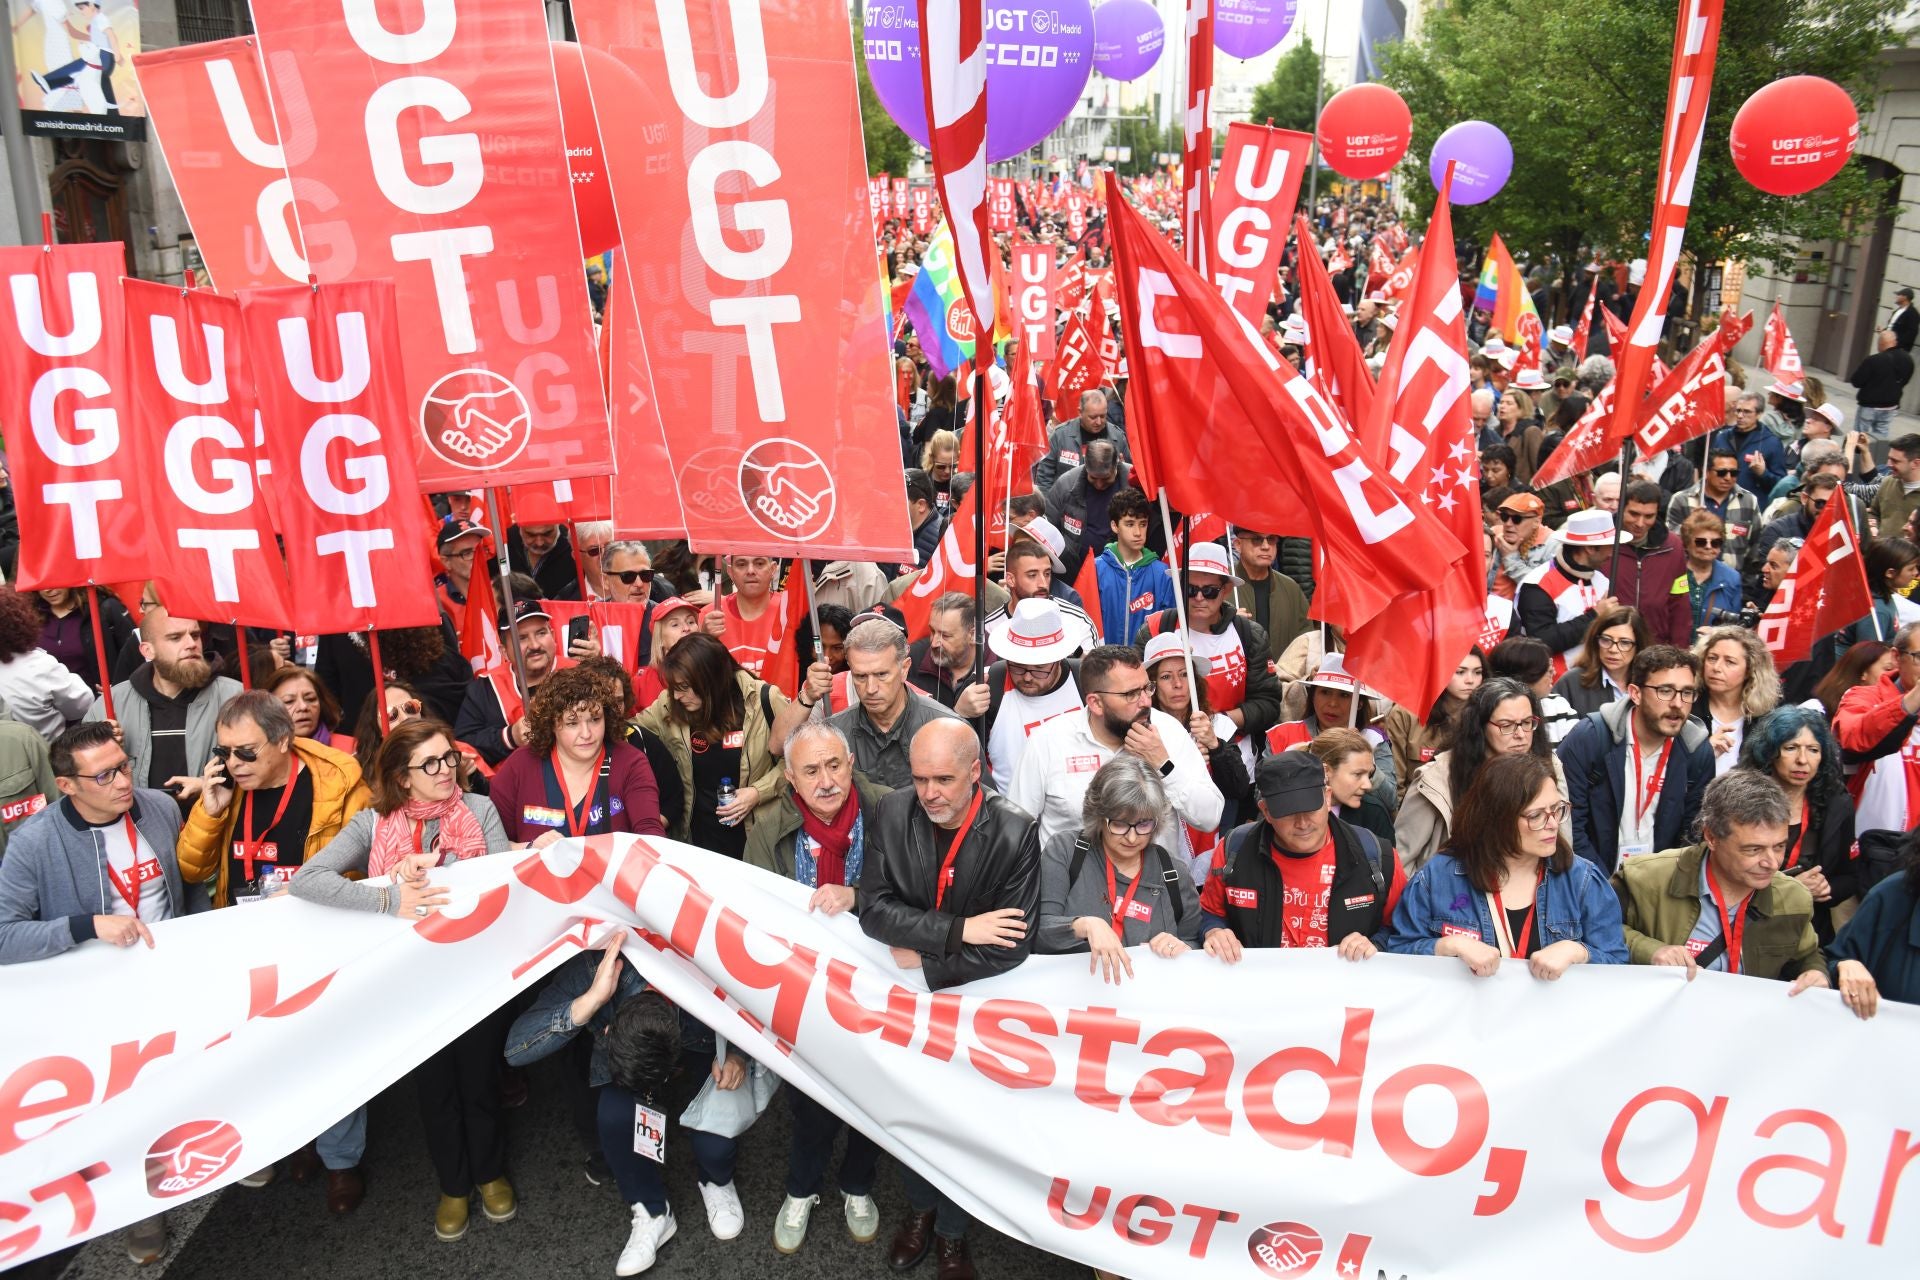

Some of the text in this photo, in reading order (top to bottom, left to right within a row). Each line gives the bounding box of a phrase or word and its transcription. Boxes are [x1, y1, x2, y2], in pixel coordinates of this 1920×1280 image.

[1060, 23, 1082, 34] Madrid
[35, 119, 124, 133] sanisidromadrid.com
[1347, 136, 1370, 146] UGT
[1772, 138, 1803, 150] UGT
[1346, 147, 1384, 158] CCOO
[1770, 152, 1821, 165] CCOO
[895, 181, 906, 215] UGT
[656, 0, 802, 423] UGT
[914, 191, 928, 231] UGT
[1068, 197, 1084, 240] UGT
[1020, 253, 1048, 353] UGT
[10, 271, 123, 560] UGT
[150, 314, 260, 603] UGT
[277, 311, 395, 608] UGT
[1130, 597, 1146, 611] UGT
[1067, 756, 1098, 766] CCOO
[2, 800, 30, 819] UGT
[524, 808, 549, 822] UGT
[274, 867, 295, 882] GT
[1228, 889, 1255, 900] CCOO
[1046, 1177, 1239, 1260] UGT
